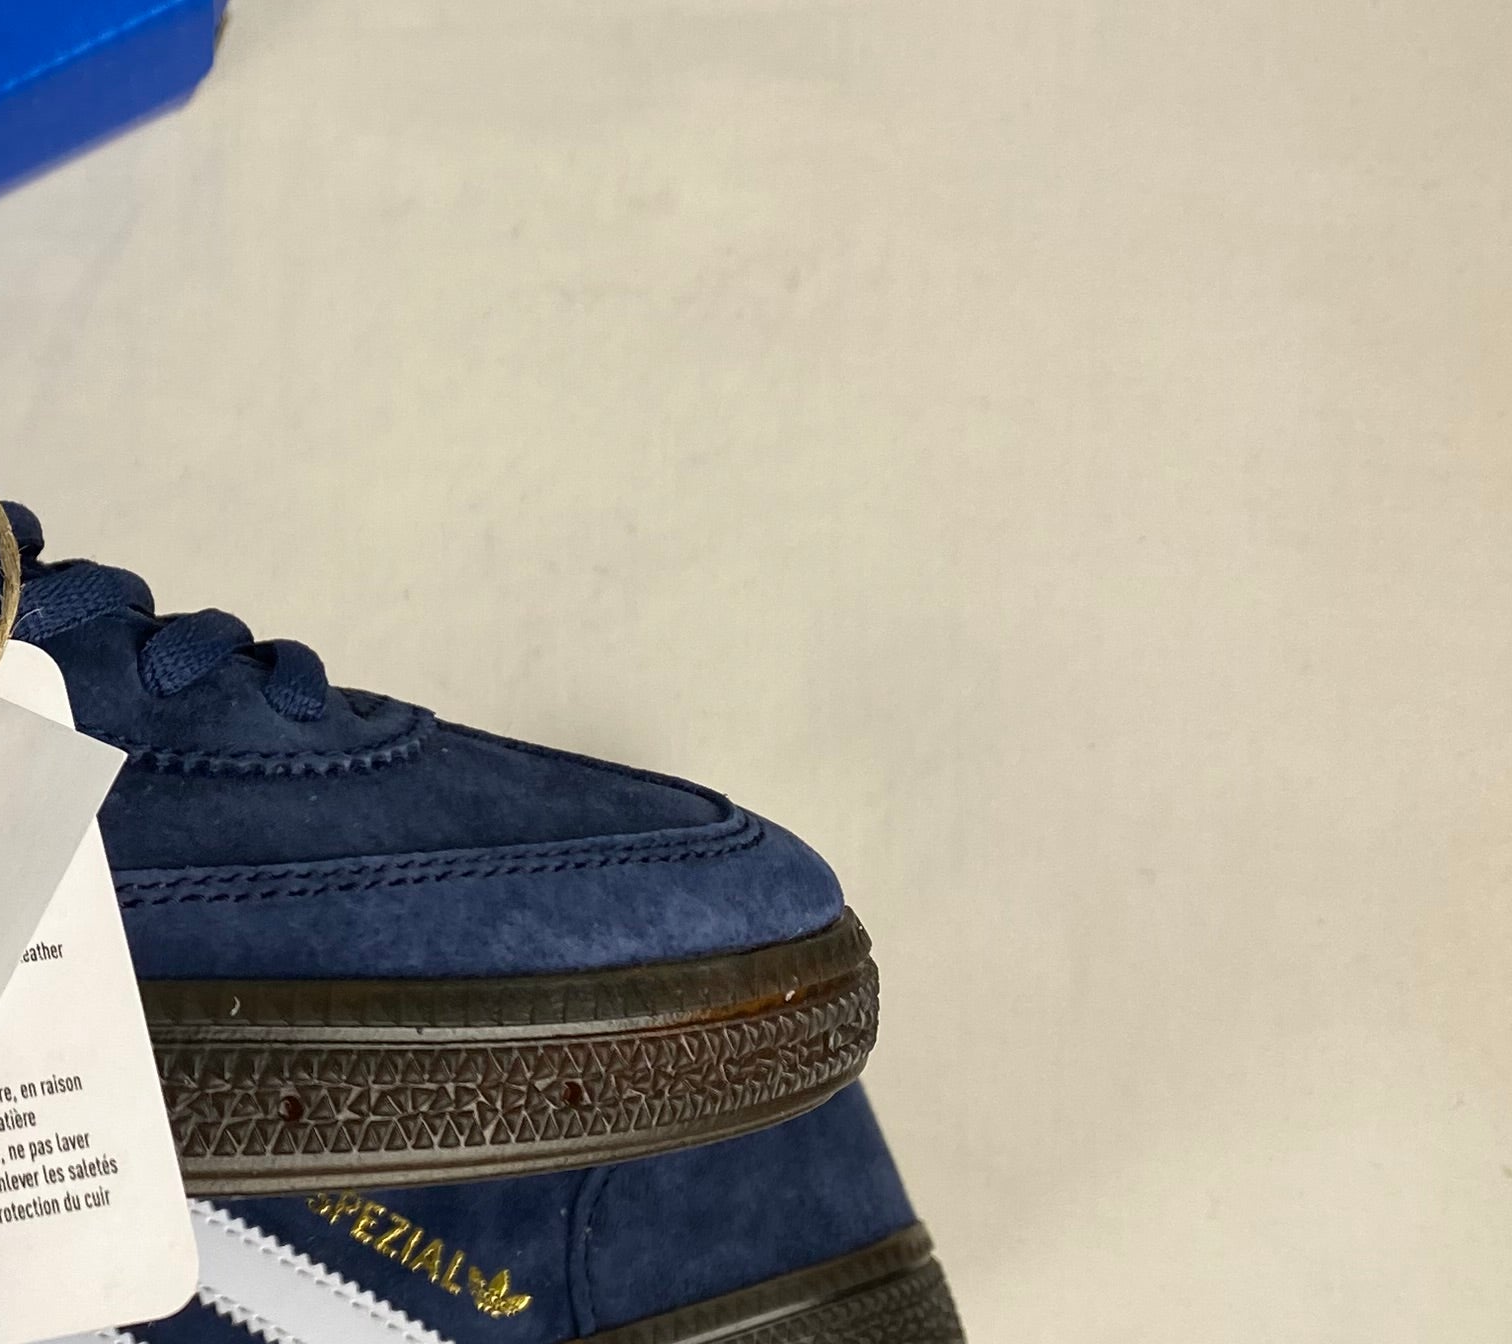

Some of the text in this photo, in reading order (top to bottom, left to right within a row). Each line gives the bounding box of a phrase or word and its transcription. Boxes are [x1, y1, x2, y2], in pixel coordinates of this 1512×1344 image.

[20, 941, 63, 963] eather
[20, 1082, 37, 1100] en
[39, 1073, 83, 1097] raison
[8, 1143, 25, 1161] ne
[29, 1137, 54, 1162] pas
[56, 1131, 91, 1153] laver
[42, 1162, 66, 1186] les
[68, 1153, 119, 1182] saletés
[63, 1190, 82, 1212] du
[84, 1185, 111, 1208] cuir
[305, 1190, 465, 1296] SPEZIAL
